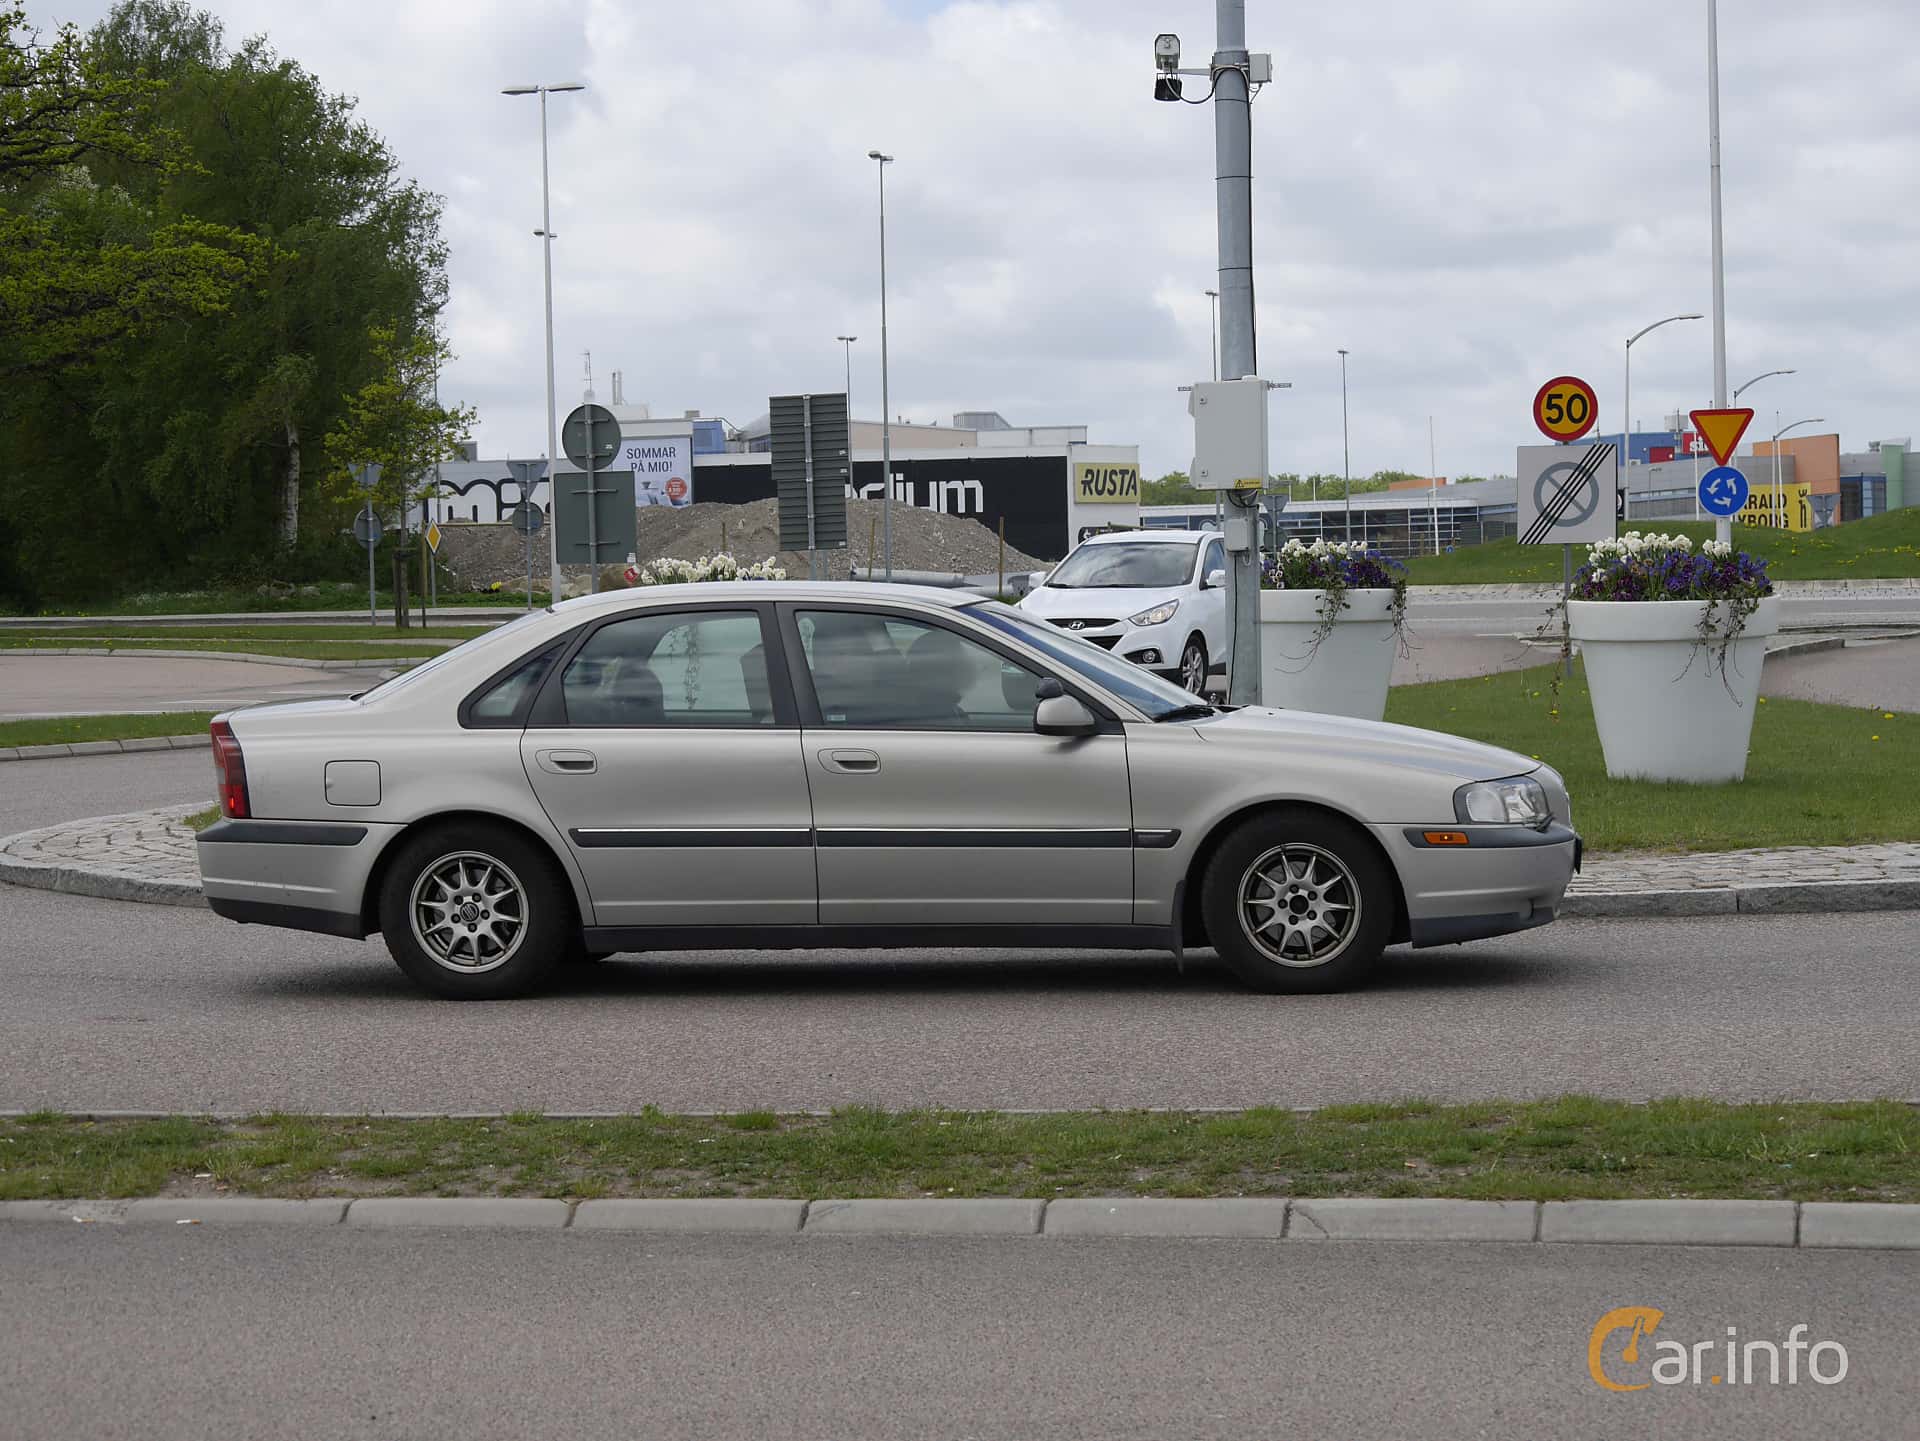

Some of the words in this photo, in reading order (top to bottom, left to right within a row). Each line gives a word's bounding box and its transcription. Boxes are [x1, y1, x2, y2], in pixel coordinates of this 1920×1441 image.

[1545, 393, 1588, 424] 50
[626, 446, 677, 460] SOMMAR
[631, 460, 645, 472] PÅ
[648, 461, 673, 472] MIO!
[1081, 469, 1138, 496] RUSTA
[844, 473, 984, 513] dium
[1744, 493, 1788, 510] RALD
[1732, 513, 1789, 529] YBORG
